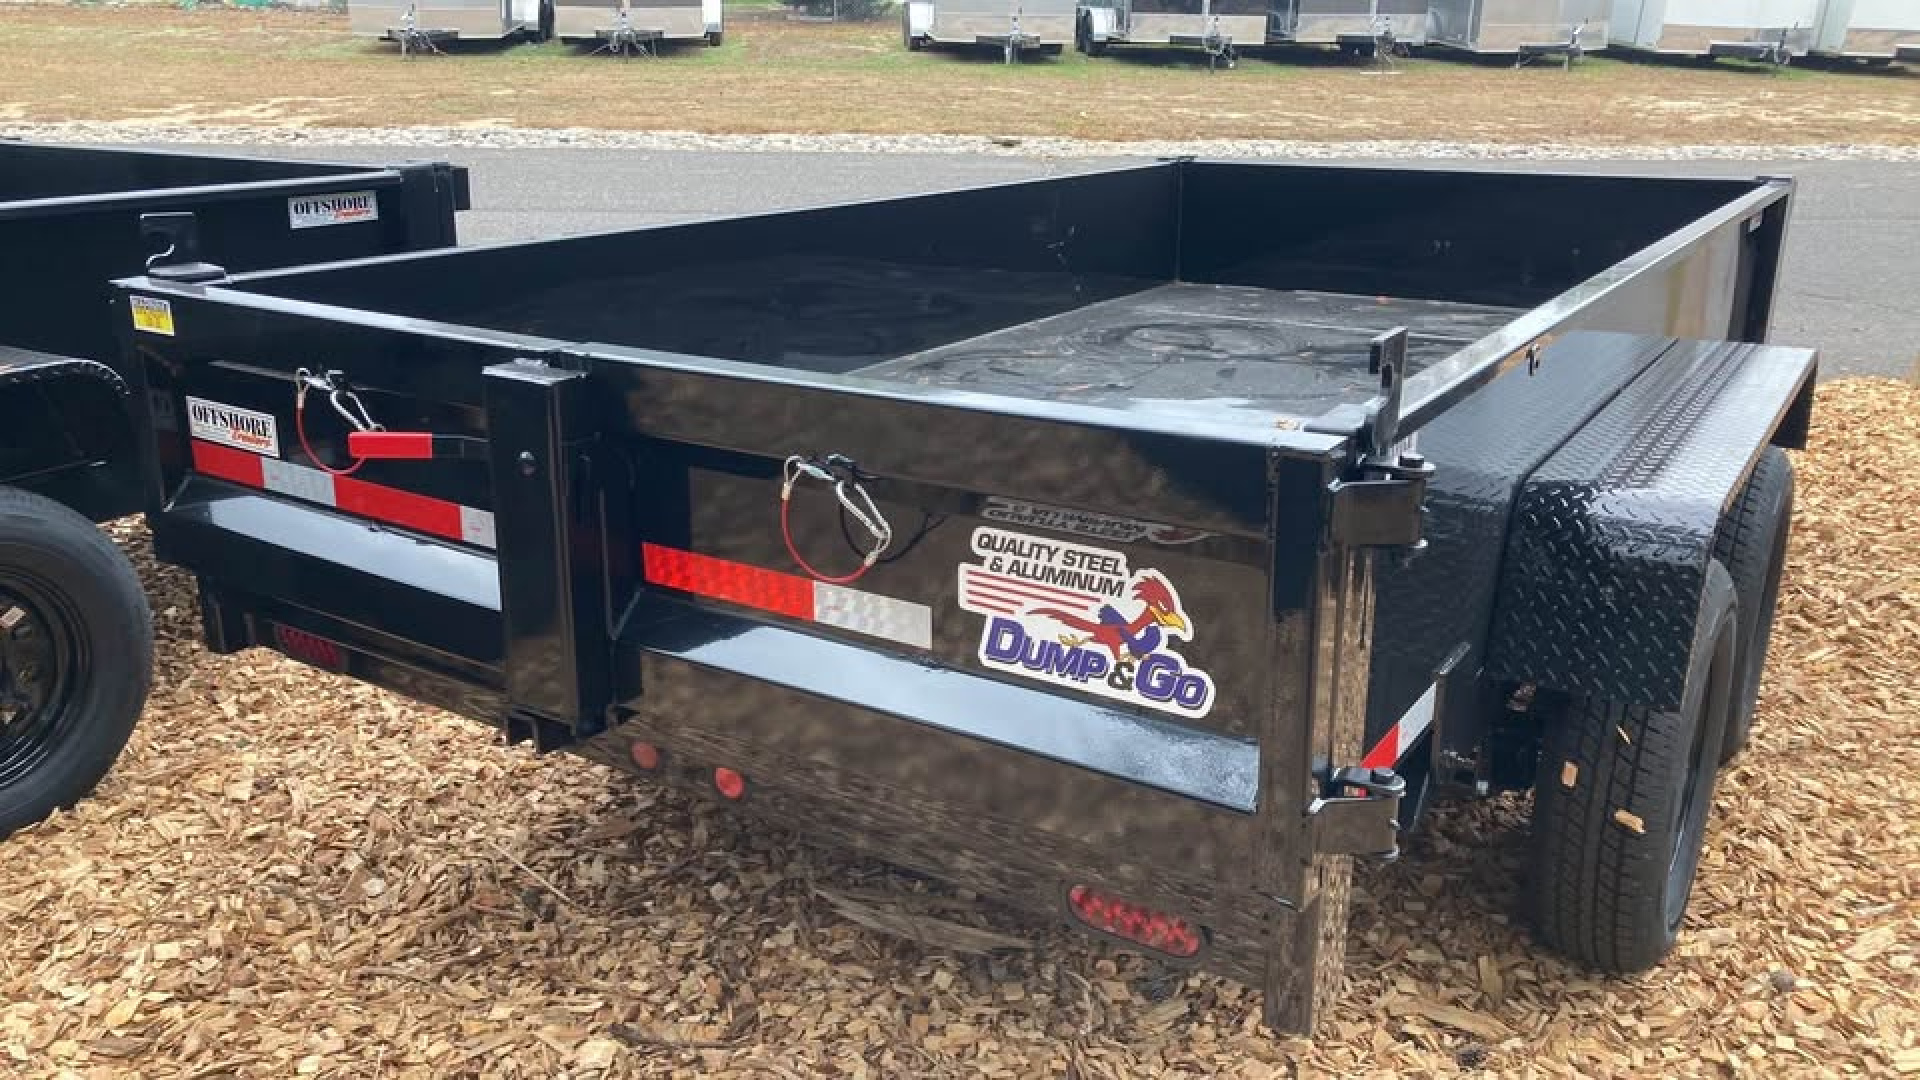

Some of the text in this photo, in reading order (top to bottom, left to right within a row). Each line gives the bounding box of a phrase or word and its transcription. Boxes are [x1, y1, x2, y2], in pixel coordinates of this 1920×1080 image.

[293, 195, 372, 214] OFFSHORE
[191, 404, 272, 437] OFFSHORE
[977, 533, 1122, 576] QUALITY STEEL
[989, 556, 1125, 598] & ALUMINUM
